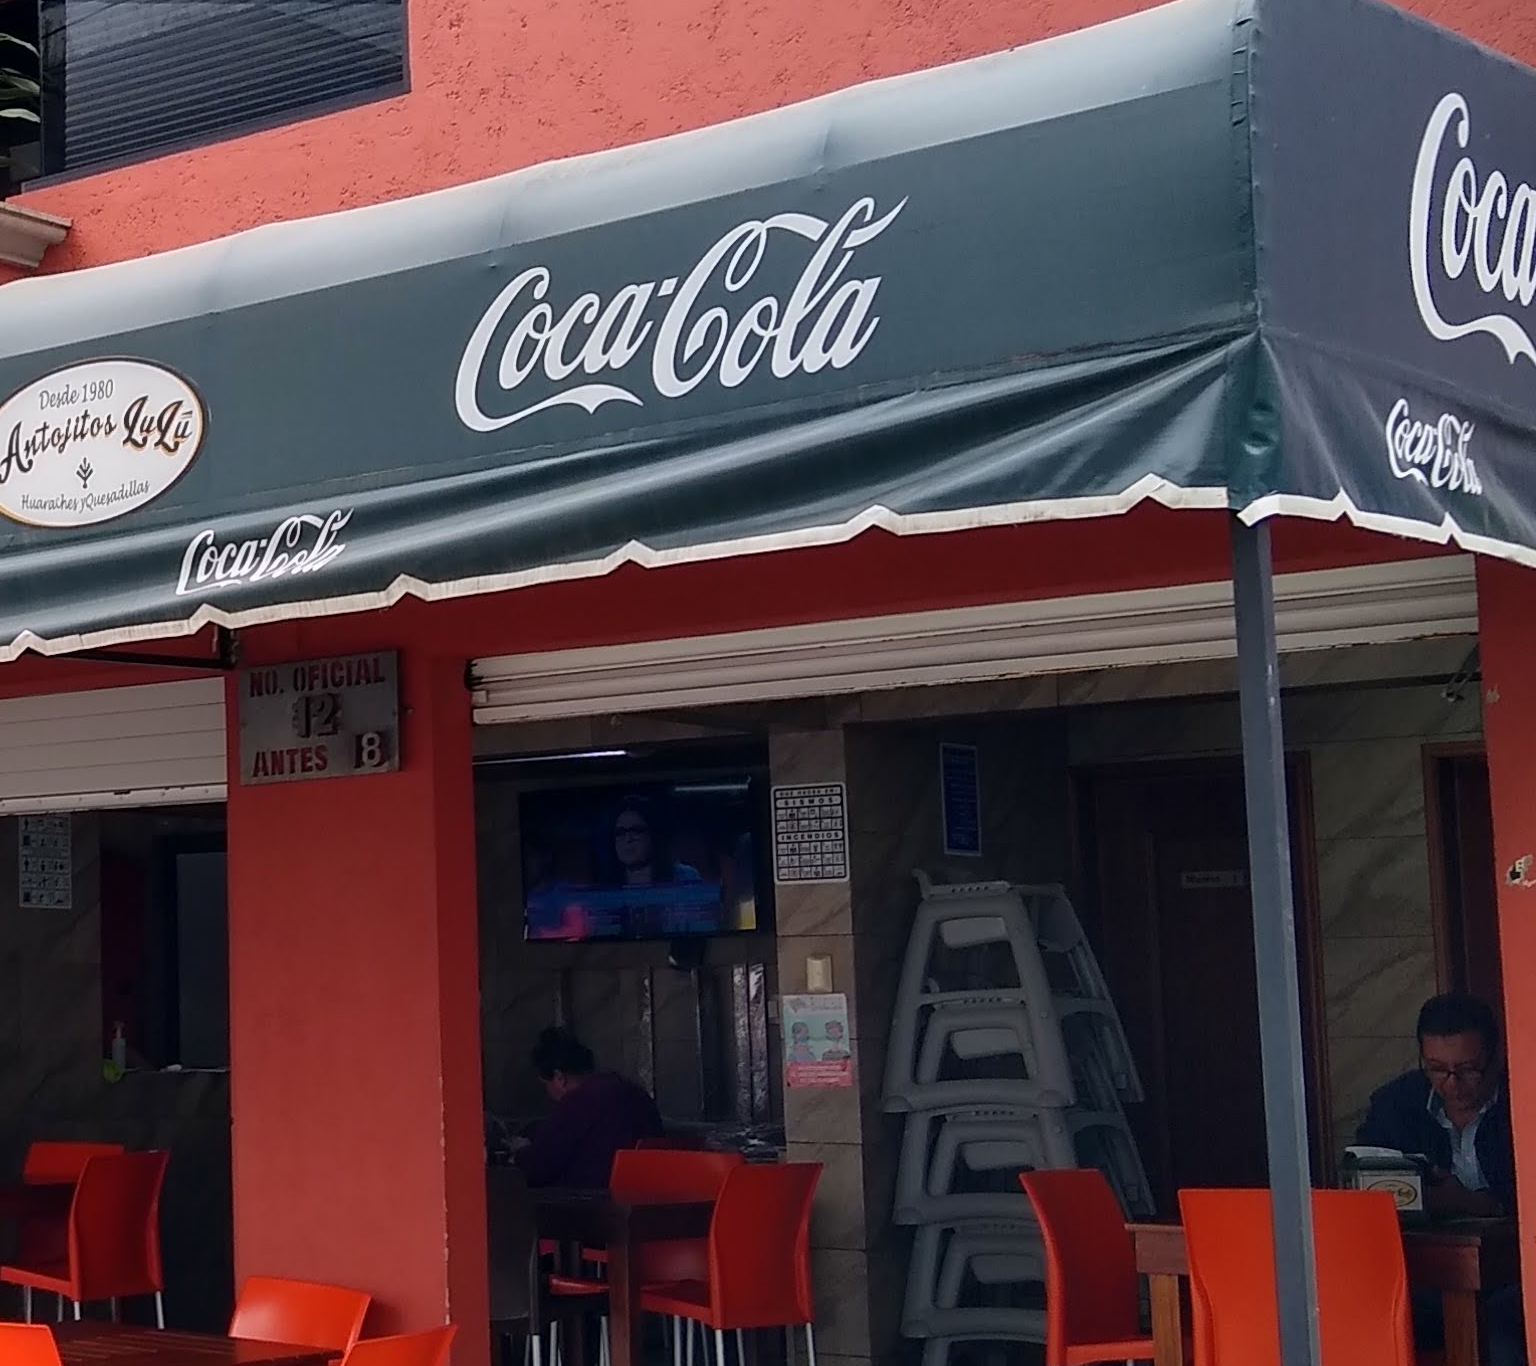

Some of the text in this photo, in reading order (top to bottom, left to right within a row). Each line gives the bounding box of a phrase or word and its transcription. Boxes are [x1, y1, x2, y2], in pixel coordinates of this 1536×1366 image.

[455, 195, 910, 433] Coca-Cola
[39, 378, 114, 411] Desde 1980
[20, 493, 79, 512] Huaraches
[293, 657, 386, 692] OFICIAL
[252, 744, 328, 778] ANTES
[784, 796, 833, 806] SISMOS
[781, 831, 839, 841] INCENDIOS
